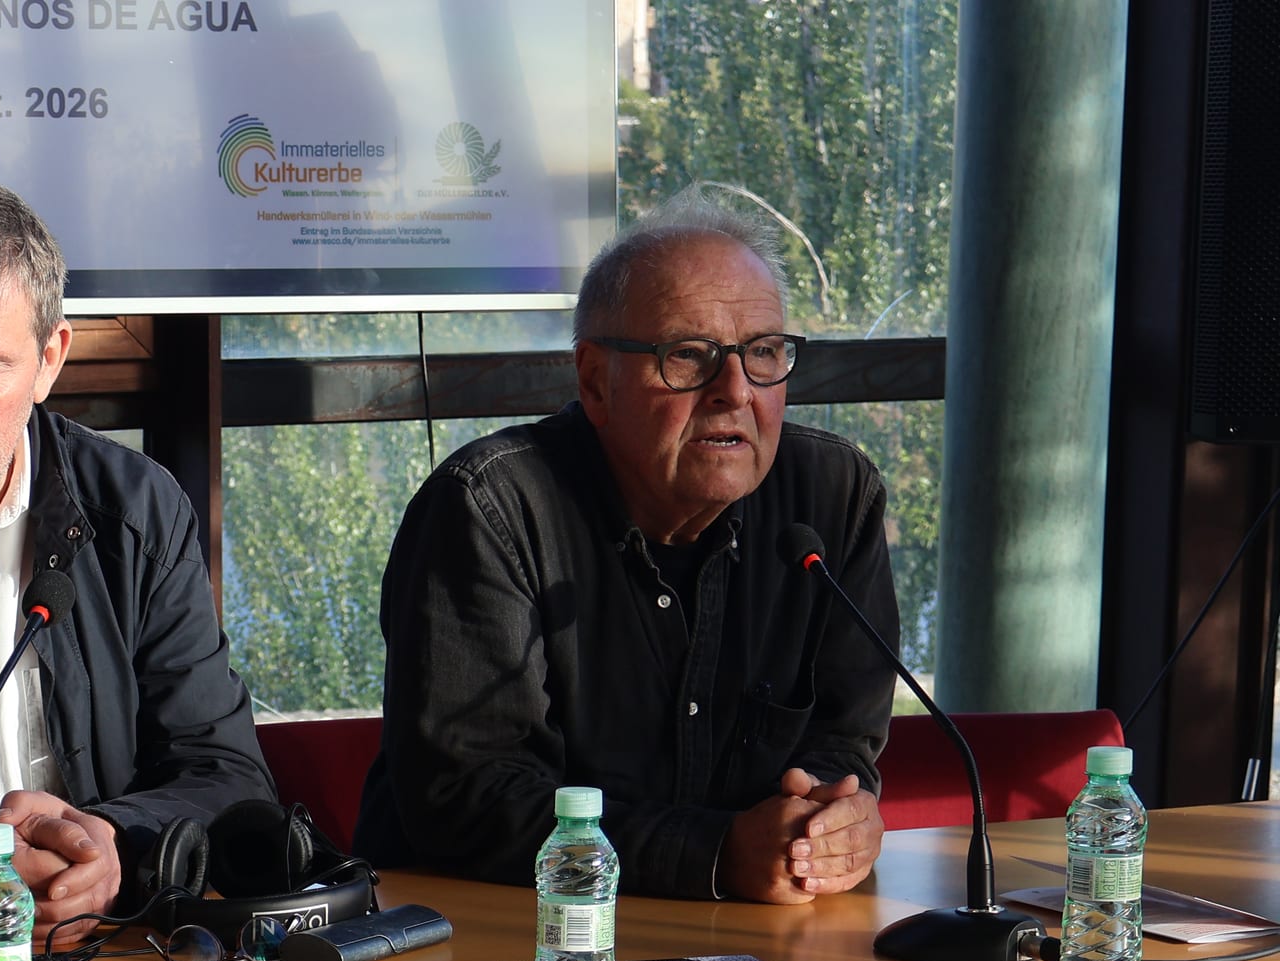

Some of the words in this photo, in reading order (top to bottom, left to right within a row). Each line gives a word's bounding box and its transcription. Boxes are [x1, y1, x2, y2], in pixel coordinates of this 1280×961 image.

[87, 0, 137, 30] DE
[147, 0, 258, 32] AGUA
[25, 87, 108, 118] 2026
[281, 140, 385, 158] Immaterielles
[254, 161, 362, 183] Kulturerbe
[1102, 859, 1118, 901] Natura
